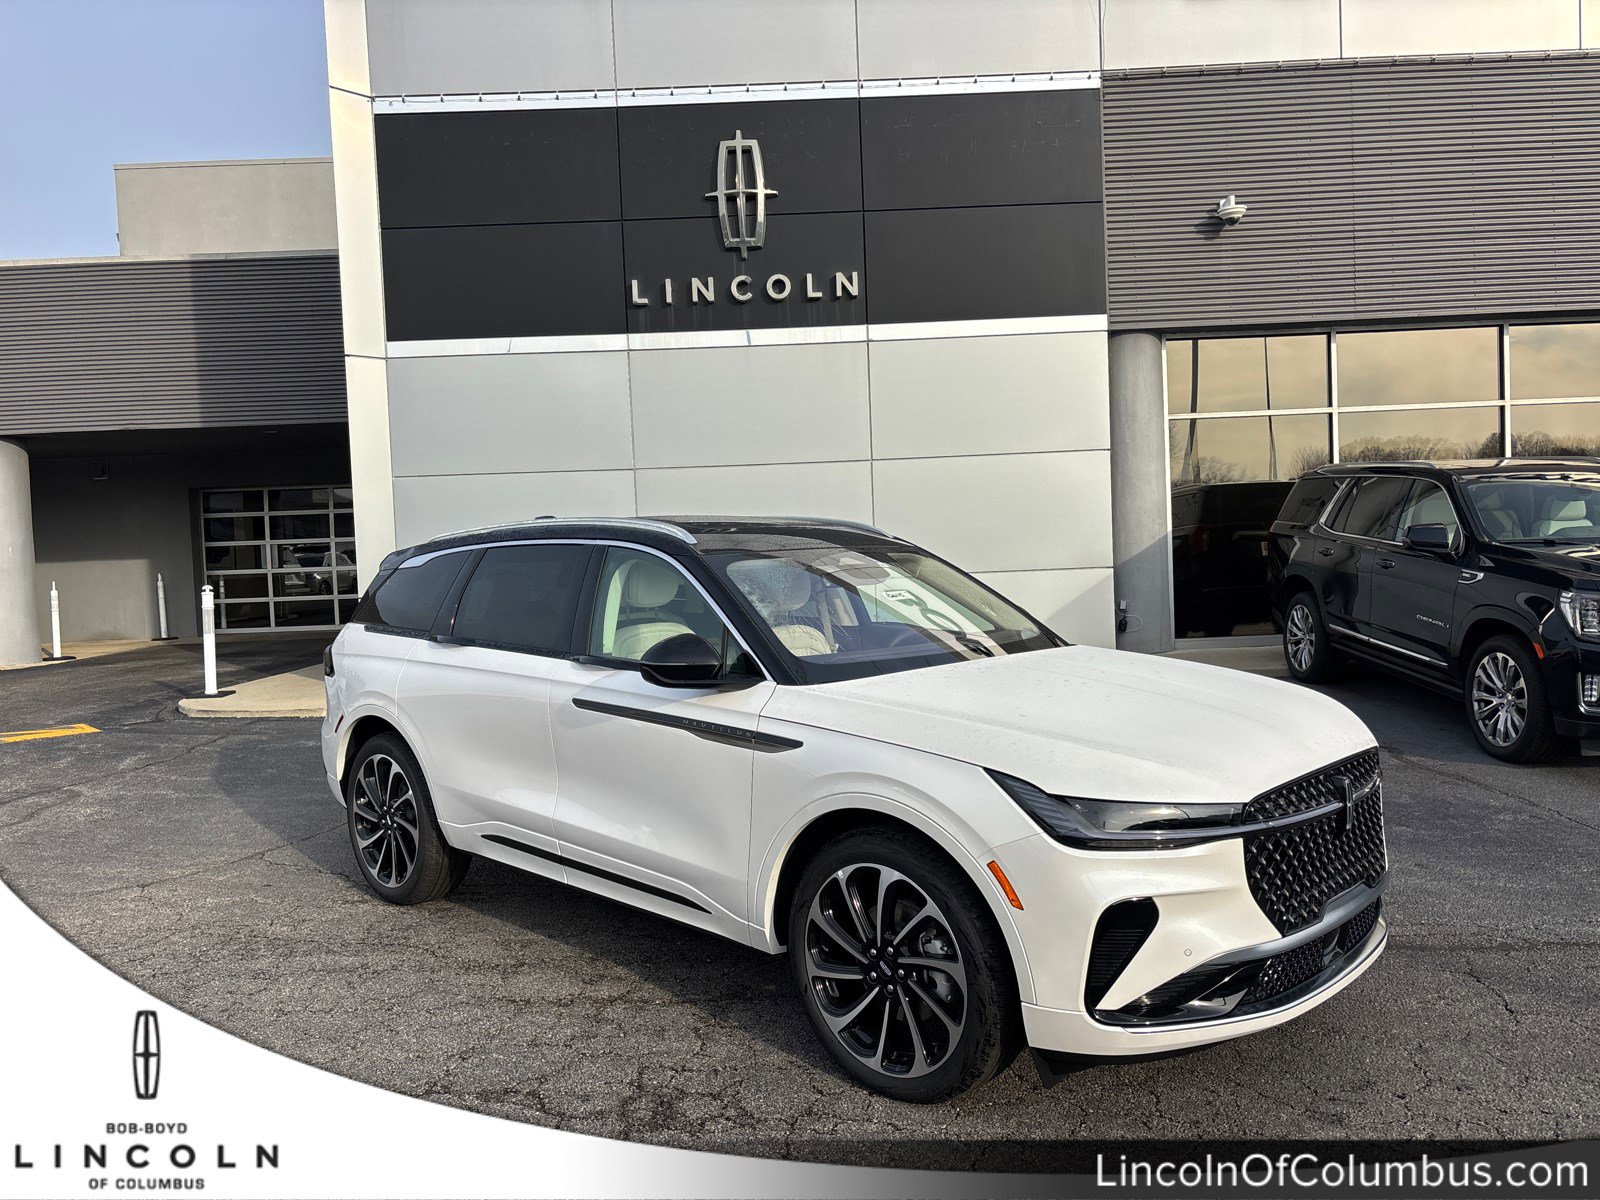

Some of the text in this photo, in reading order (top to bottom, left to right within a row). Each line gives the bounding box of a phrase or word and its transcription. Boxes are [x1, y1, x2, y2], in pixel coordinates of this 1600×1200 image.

[631, 271, 859, 305] LINCOLN
[1416, 614, 1450, 628] DENALI
[682, 719, 752, 738] NAUTILUS
